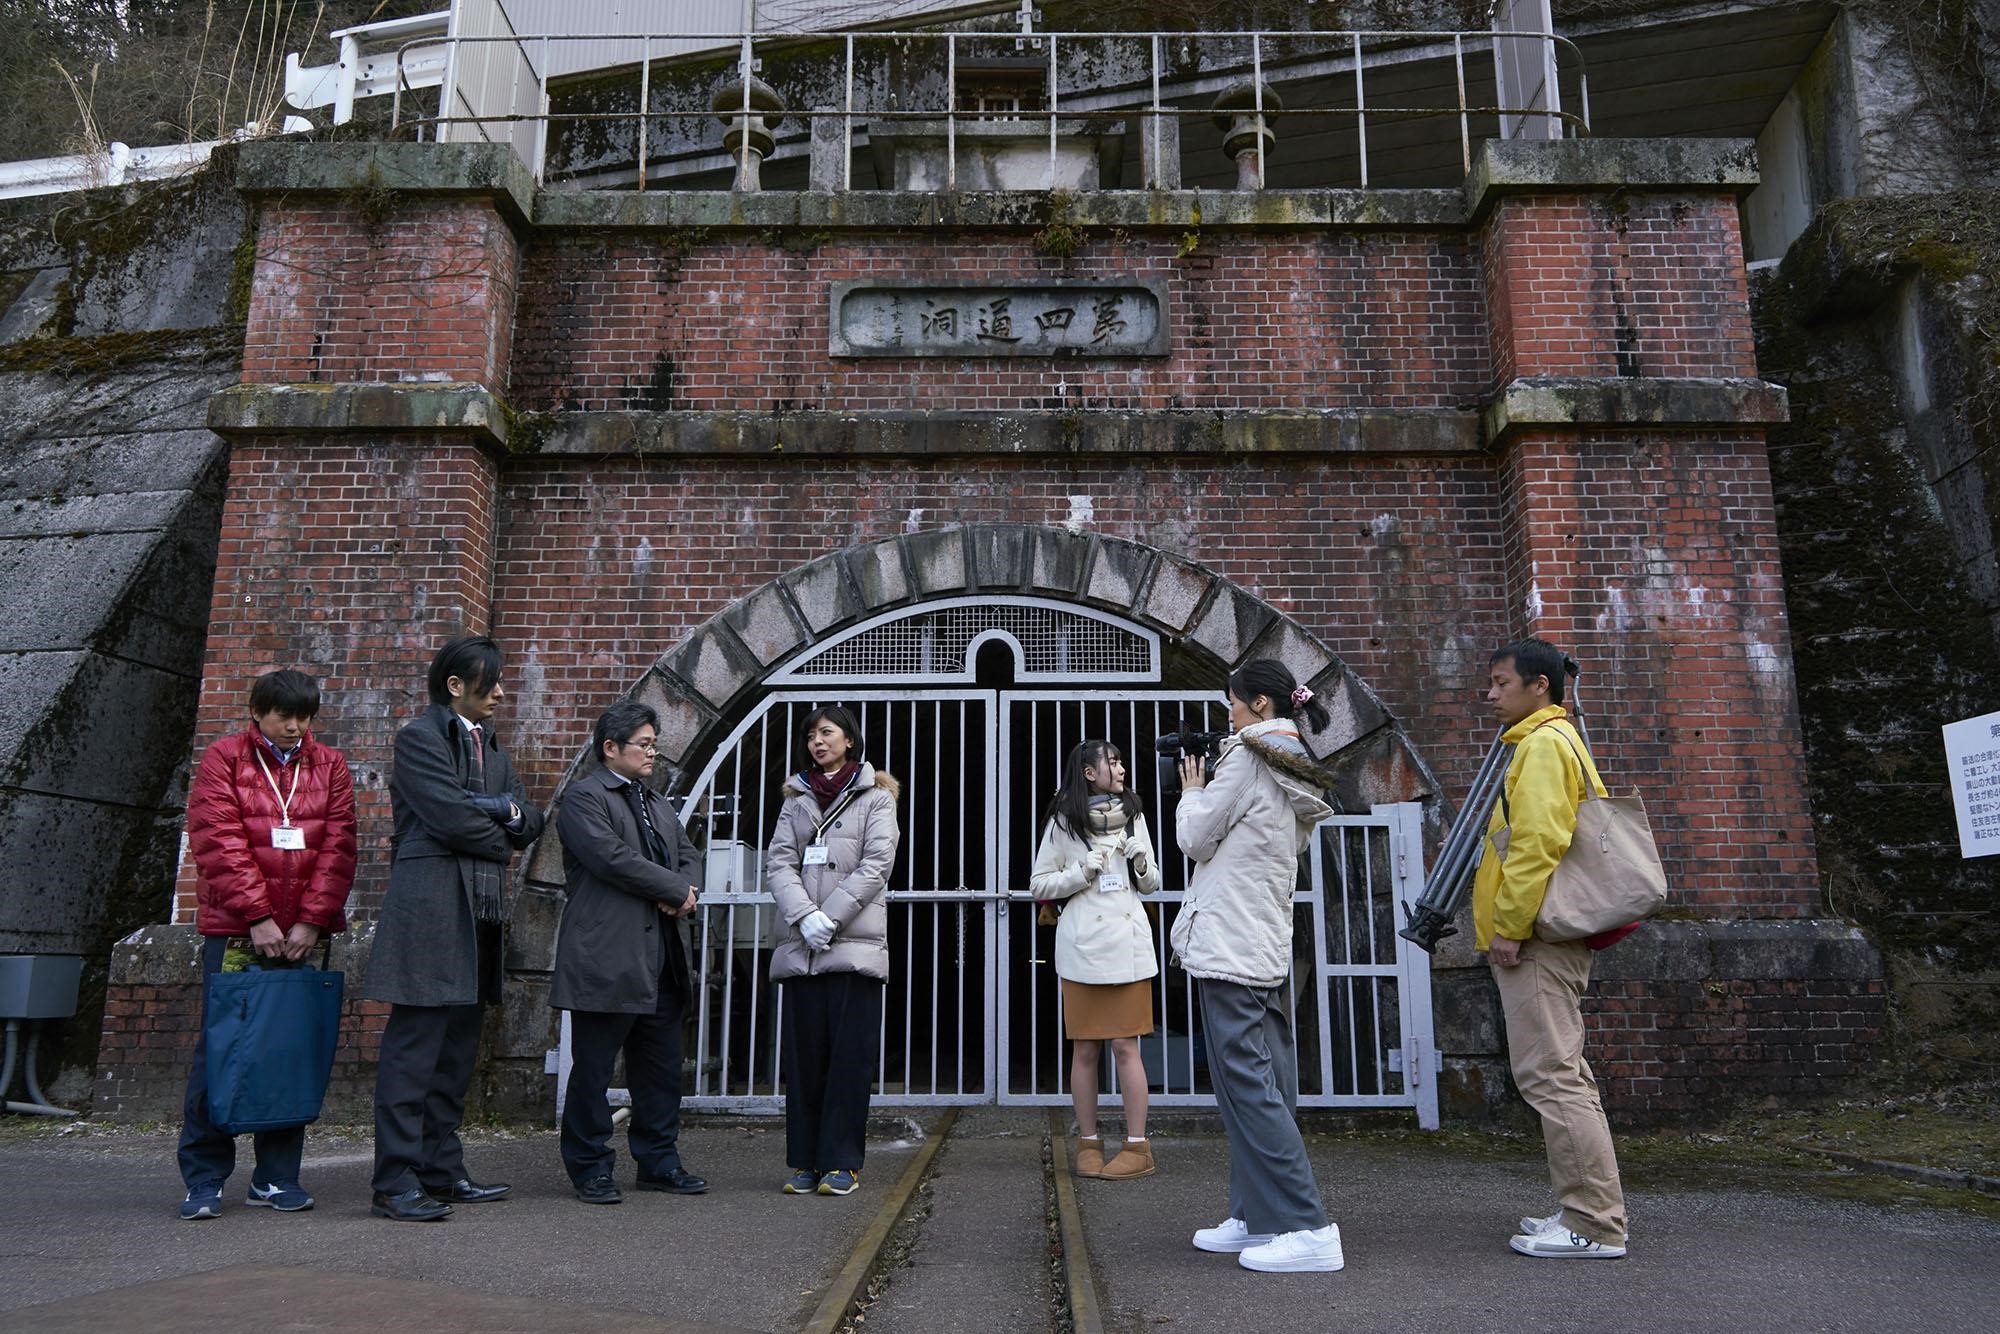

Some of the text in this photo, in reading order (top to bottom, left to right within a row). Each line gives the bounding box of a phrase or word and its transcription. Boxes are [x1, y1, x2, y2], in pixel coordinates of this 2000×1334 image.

[1966, 775, 2000, 790] 銅山の大動
